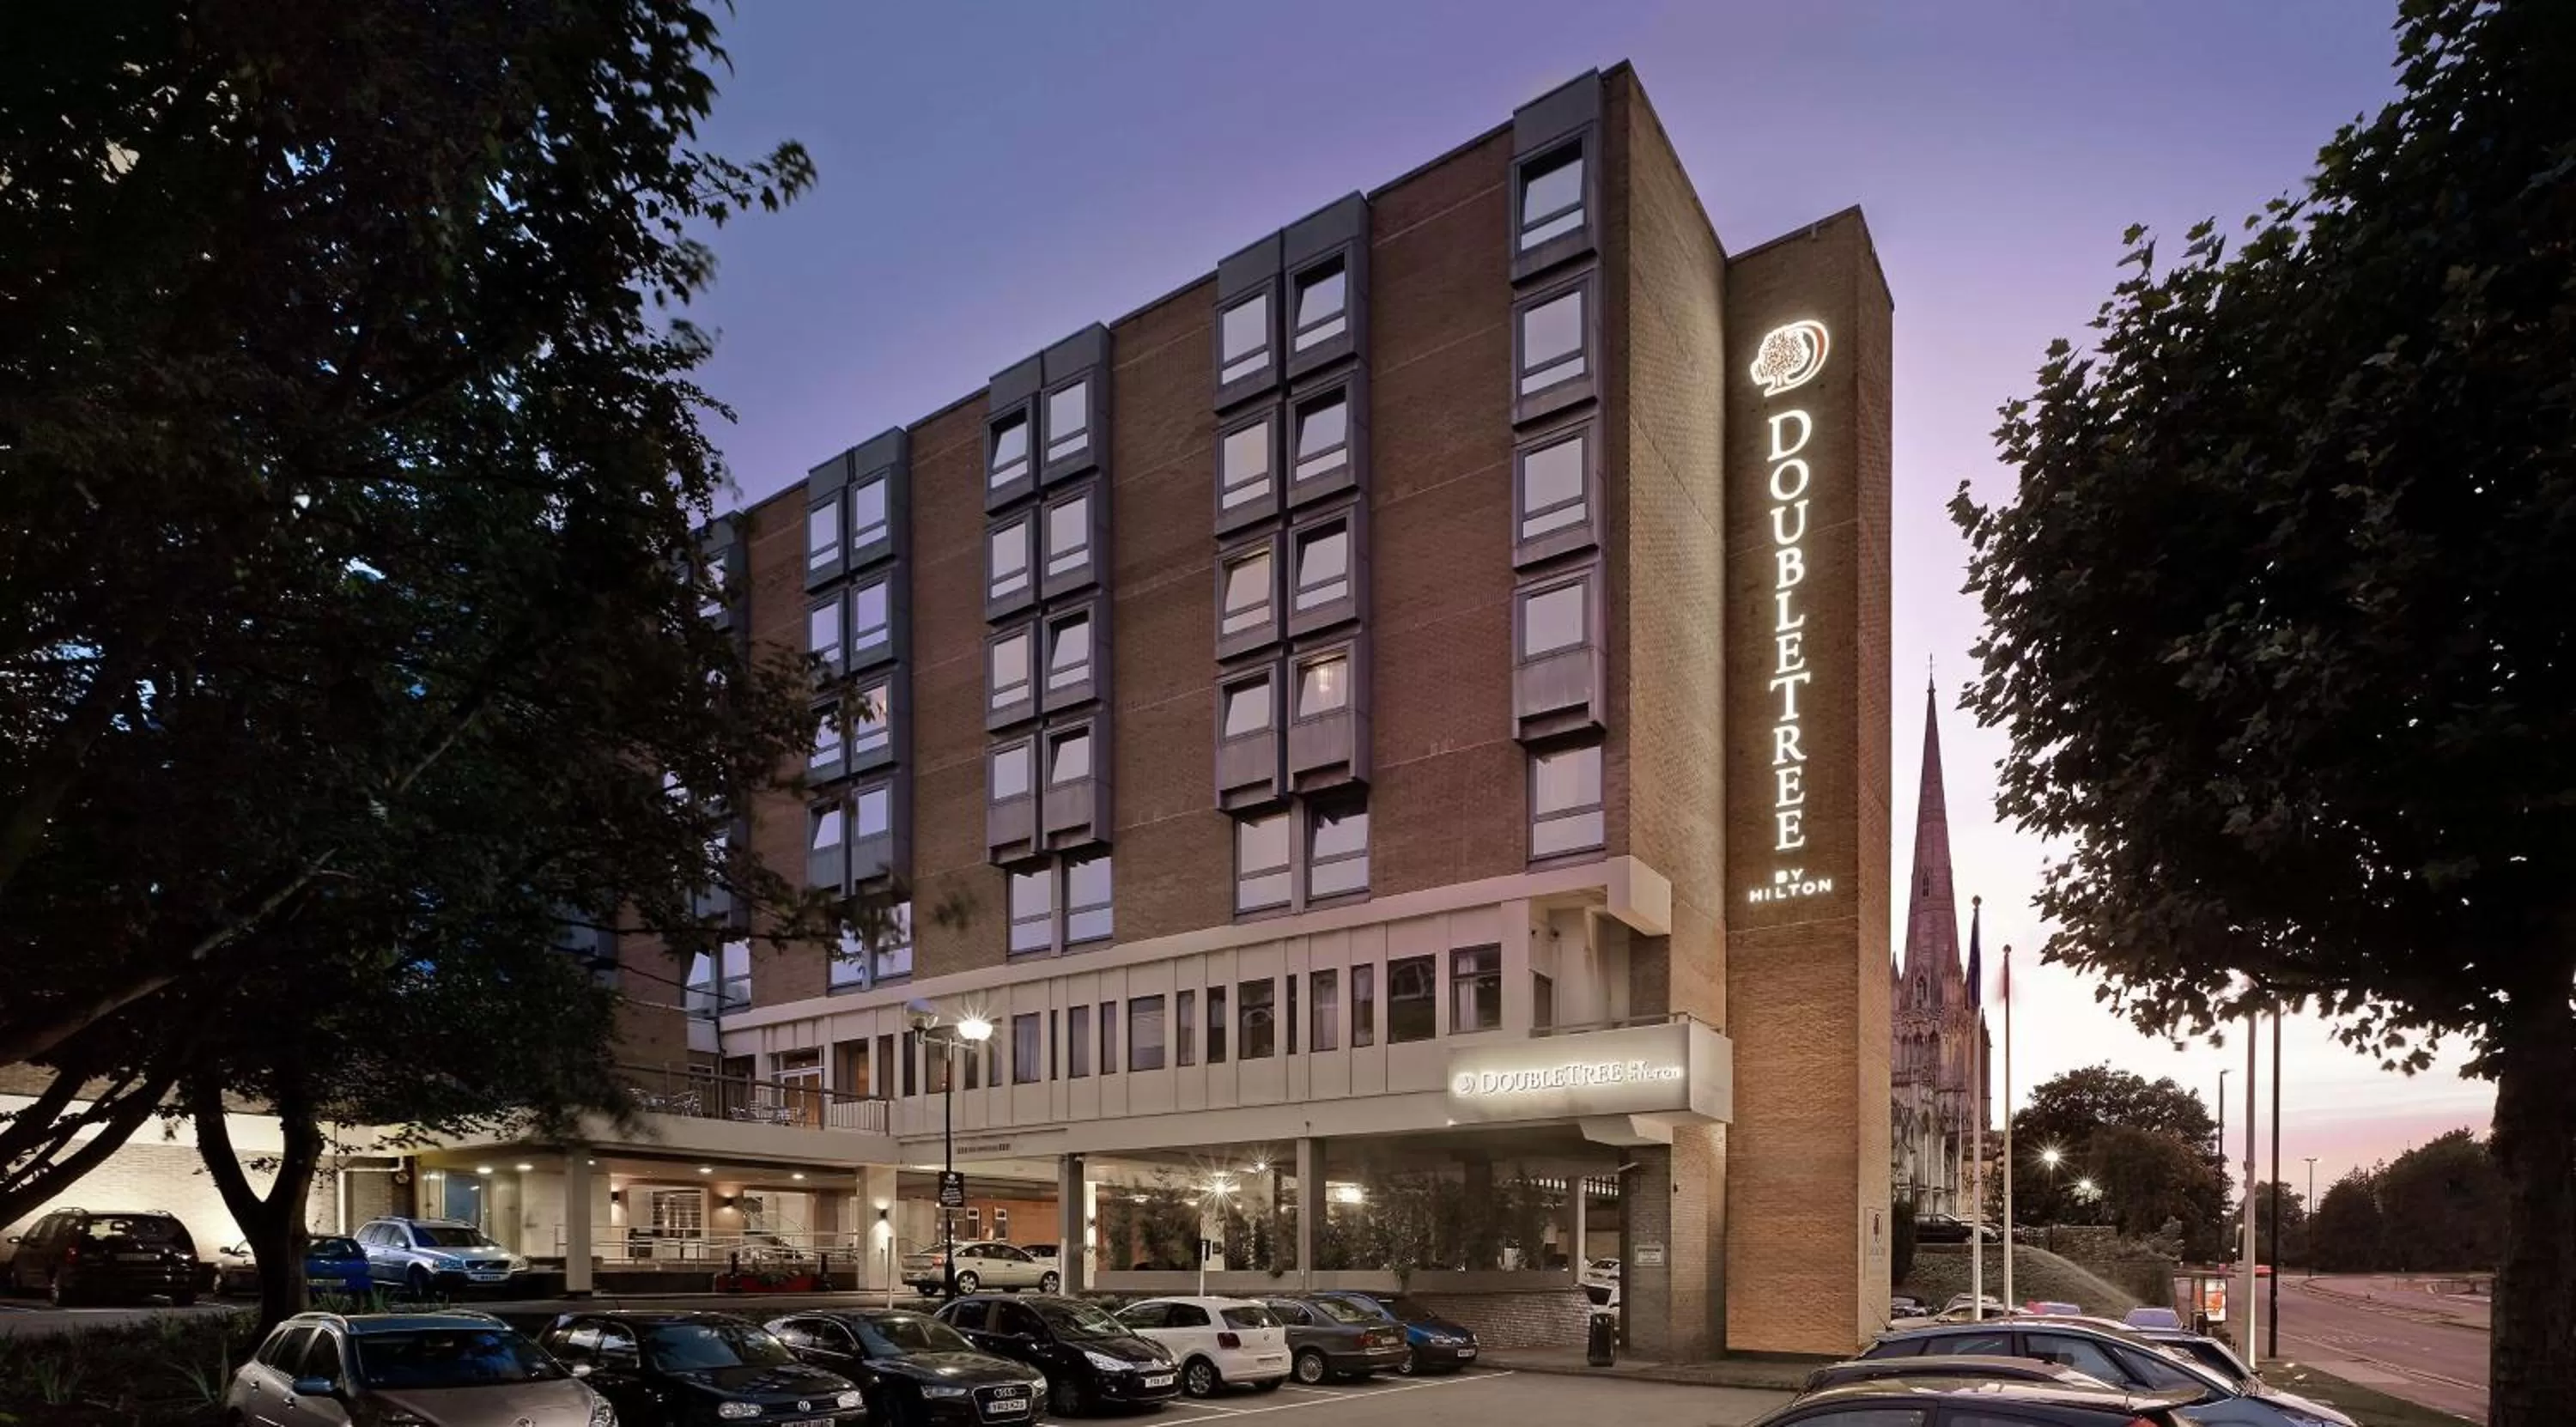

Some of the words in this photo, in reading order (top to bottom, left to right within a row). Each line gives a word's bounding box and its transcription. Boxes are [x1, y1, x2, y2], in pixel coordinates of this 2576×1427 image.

[1766, 409, 1812, 851] DOUBLETREE
[1749, 878, 1832, 902] HILTON
[1775, 868, 1804, 884] BY
[1481, 1062, 1624, 1094] DOUBLETREE
